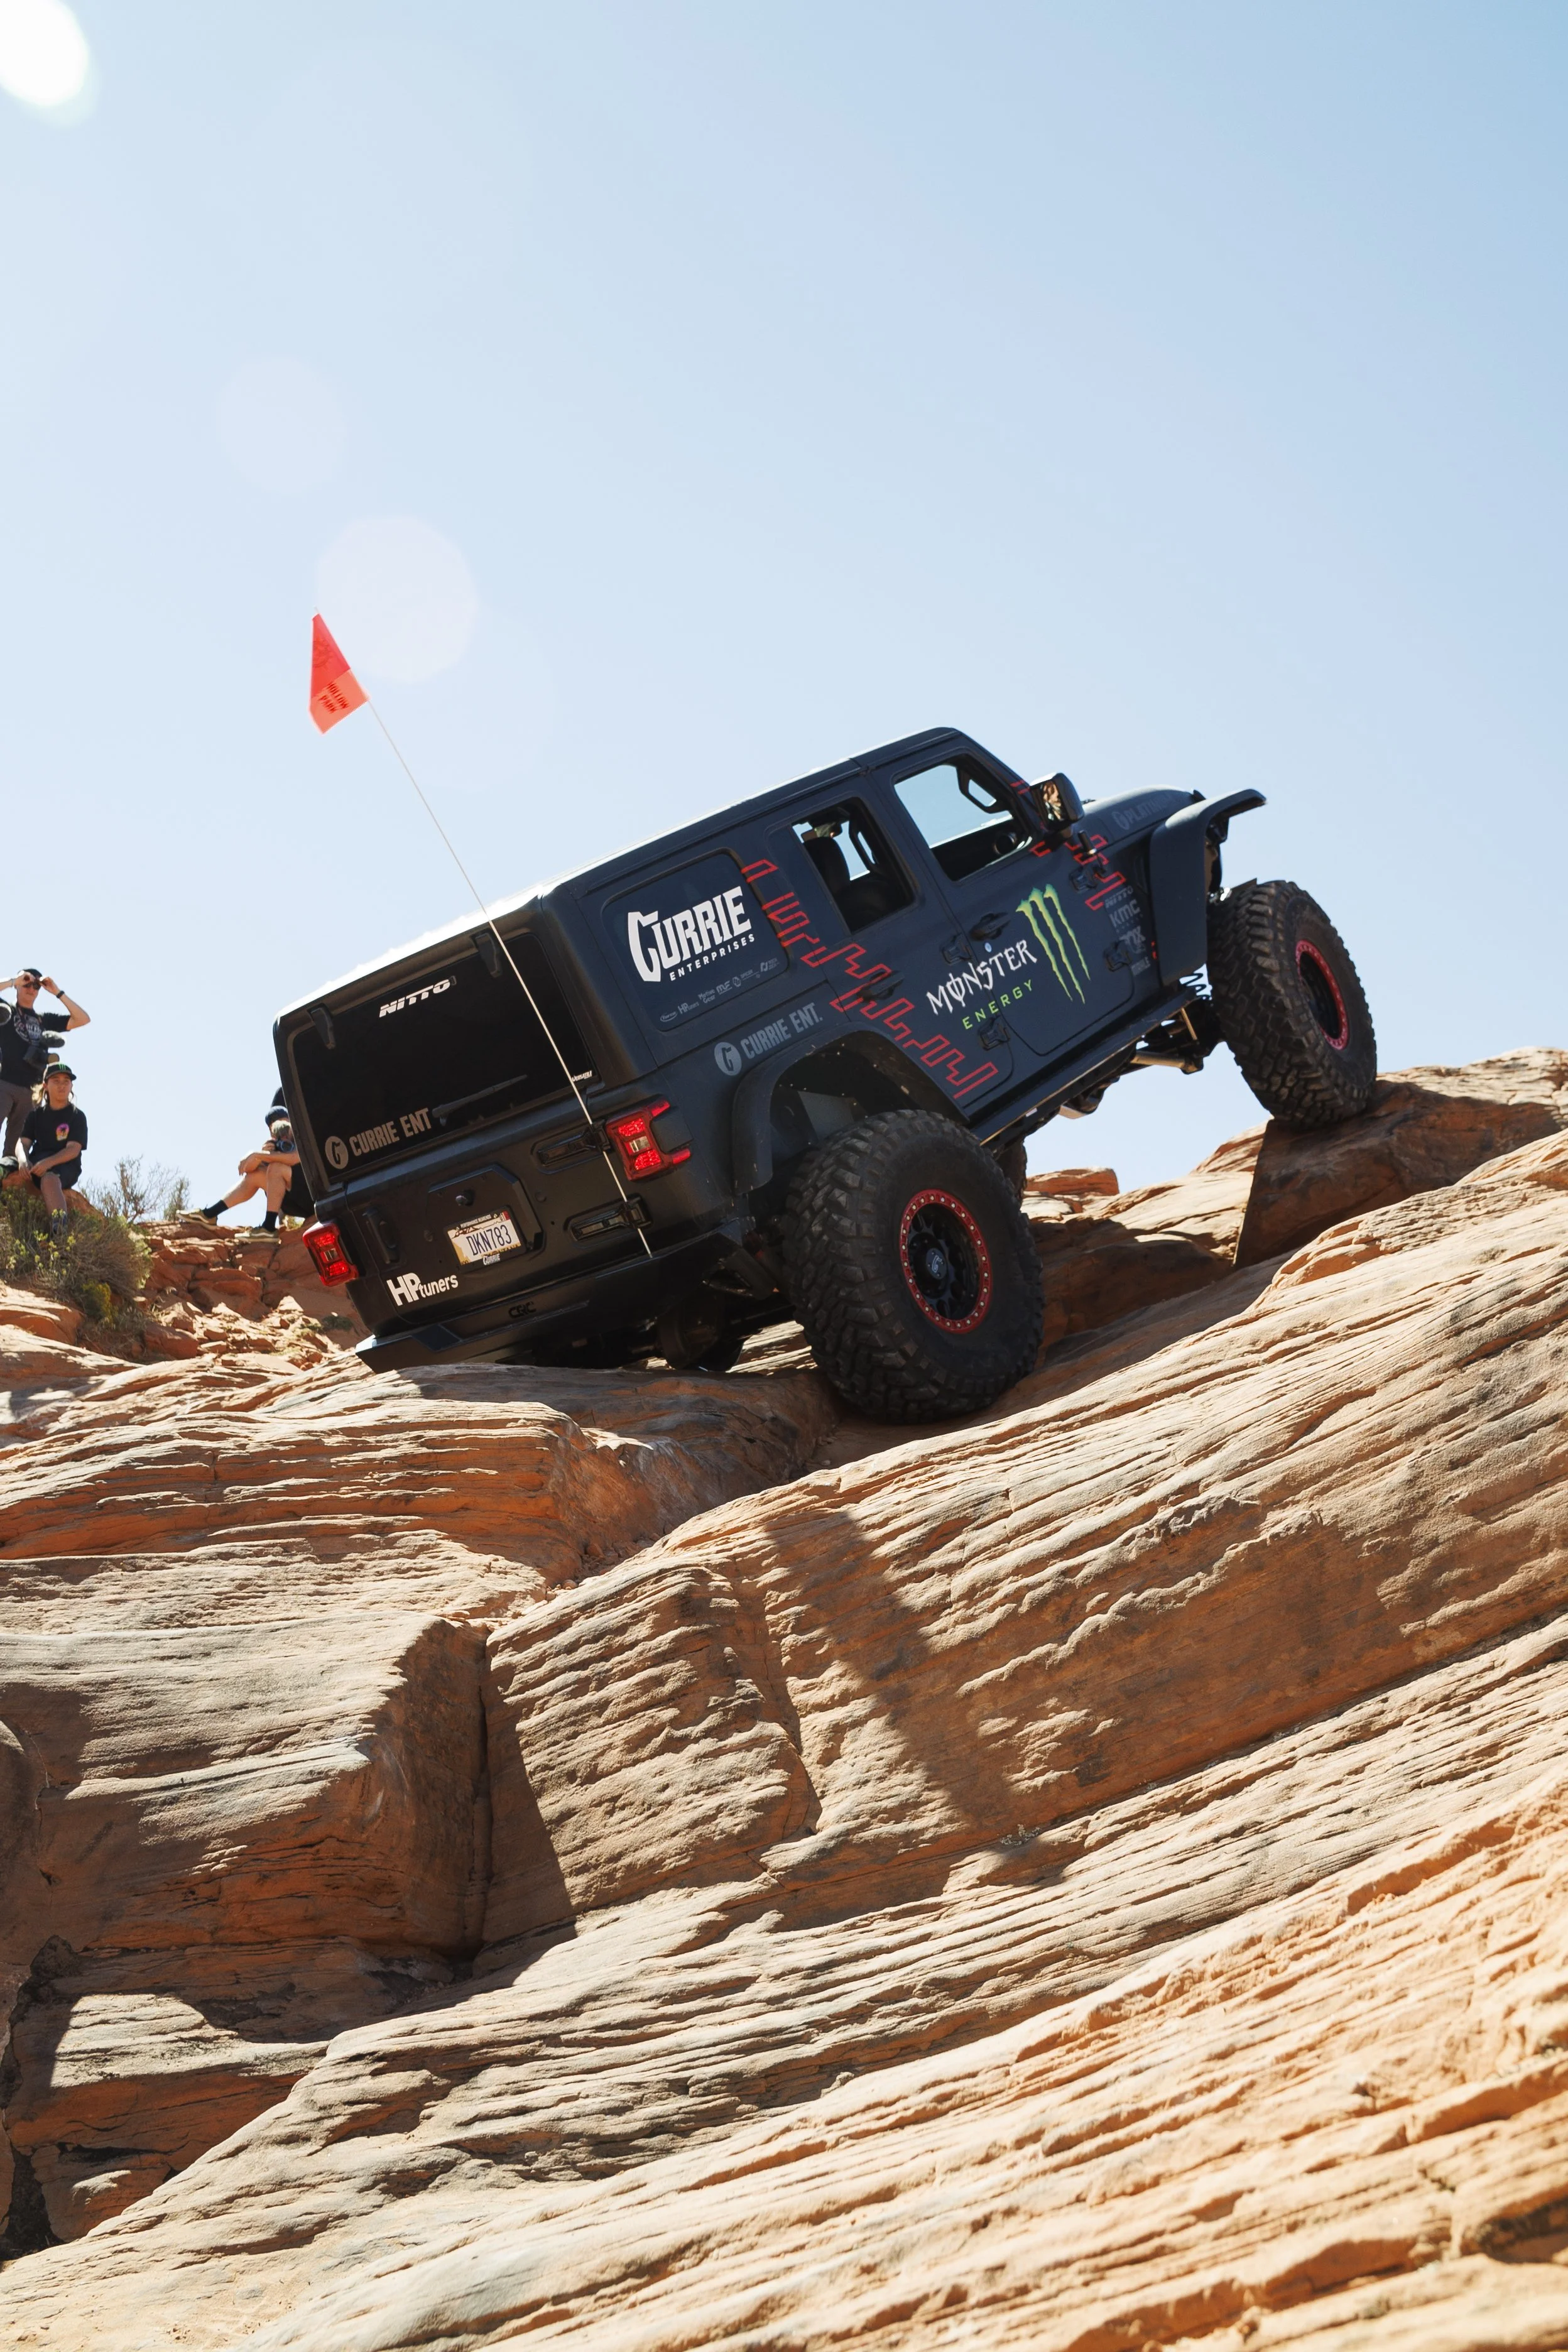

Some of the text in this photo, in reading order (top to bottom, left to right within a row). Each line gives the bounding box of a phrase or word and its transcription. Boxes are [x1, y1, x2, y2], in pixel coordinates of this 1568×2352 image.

[628, 886, 751, 982] CURRIE
[670, 934, 754, 981] ENTERPRISES
[379, 978, 450, 1018] NITTO
[926, 940, 1037, 1015] MONSTER
[962, 979, 1033, 1030] ENERGY
[740, 1018, 792, 1060] CURRIE
[788, 1003, 824, 1033] ENT.
[349, 1121, 400, 1157] CURRIE
[400, 1108, 433, 1137] ENT
[466, 1224, 512, 1256] DKN783
